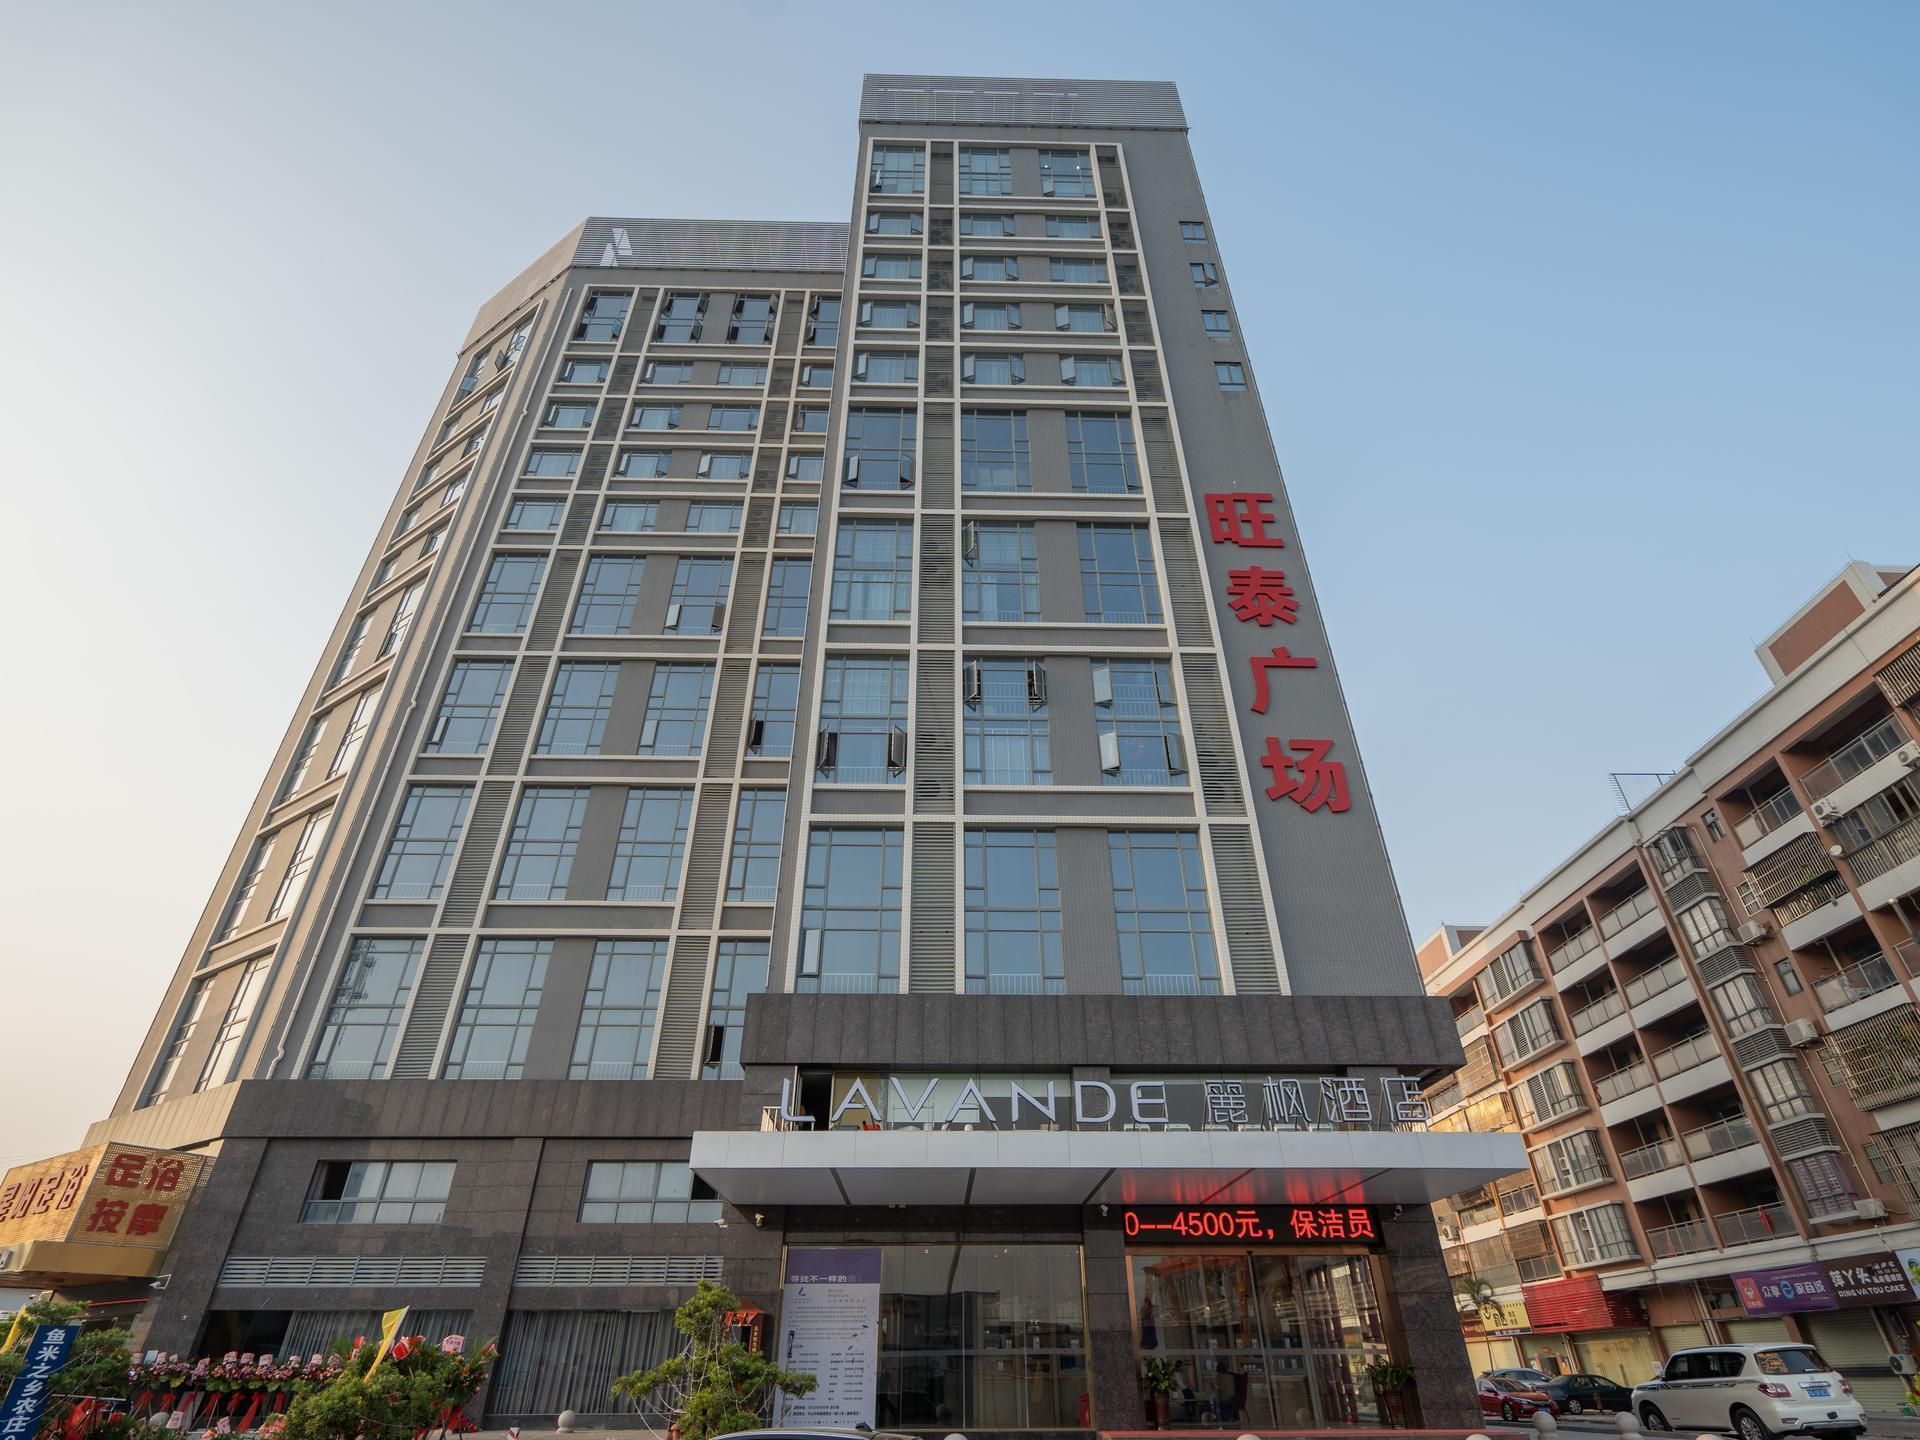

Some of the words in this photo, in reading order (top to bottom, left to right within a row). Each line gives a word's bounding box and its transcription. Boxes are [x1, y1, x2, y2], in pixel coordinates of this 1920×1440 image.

[1205, 492, 1352, 813] 旺泰广场
[781, 1076, 1170, 1124] LAVANDE
[1203, 1075, 1430, 1124] 麗枫酒店
[105, 1153, 185, 1193] 足浴
[86, 1198, 169, 1235] 按摩
[1884, 1284, 1907, 1293] CAKE
[2, 1328, 66, 1433] 鱼米之乡农庄
